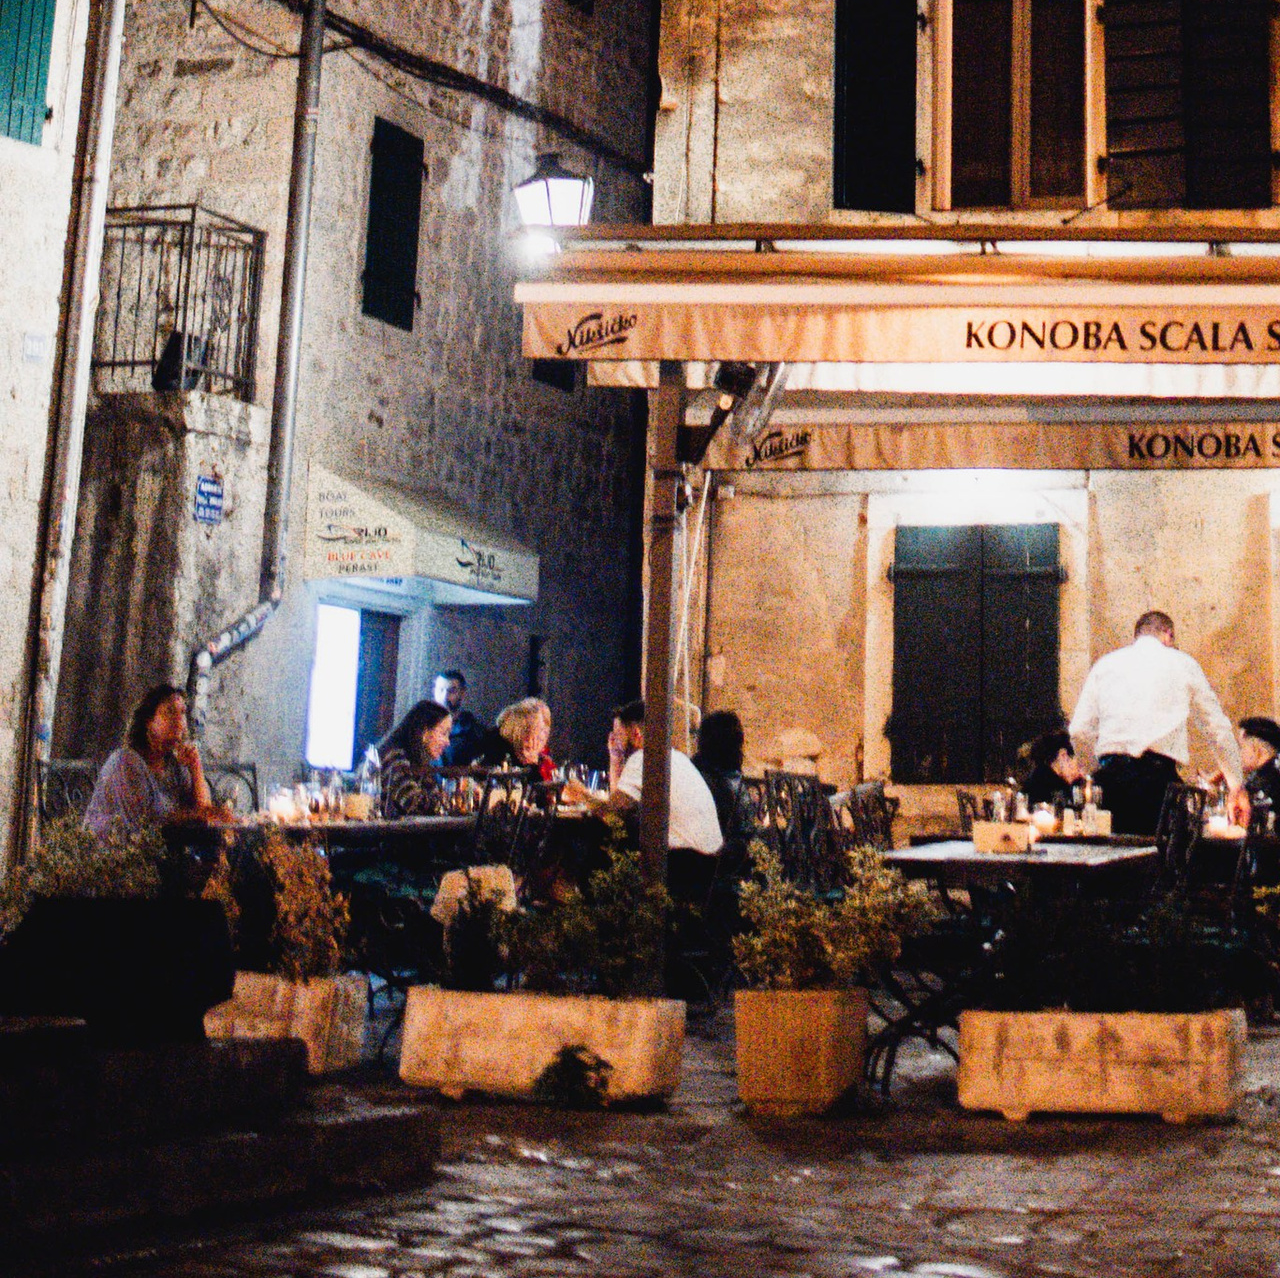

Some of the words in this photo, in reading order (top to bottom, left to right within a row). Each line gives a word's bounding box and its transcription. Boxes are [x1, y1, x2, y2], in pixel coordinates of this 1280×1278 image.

[966, 320, 1128, 351] KONOBA
[1139, 320, 1255, 352] SCALA
[1128, 434, 1263, 460] KONOBA
